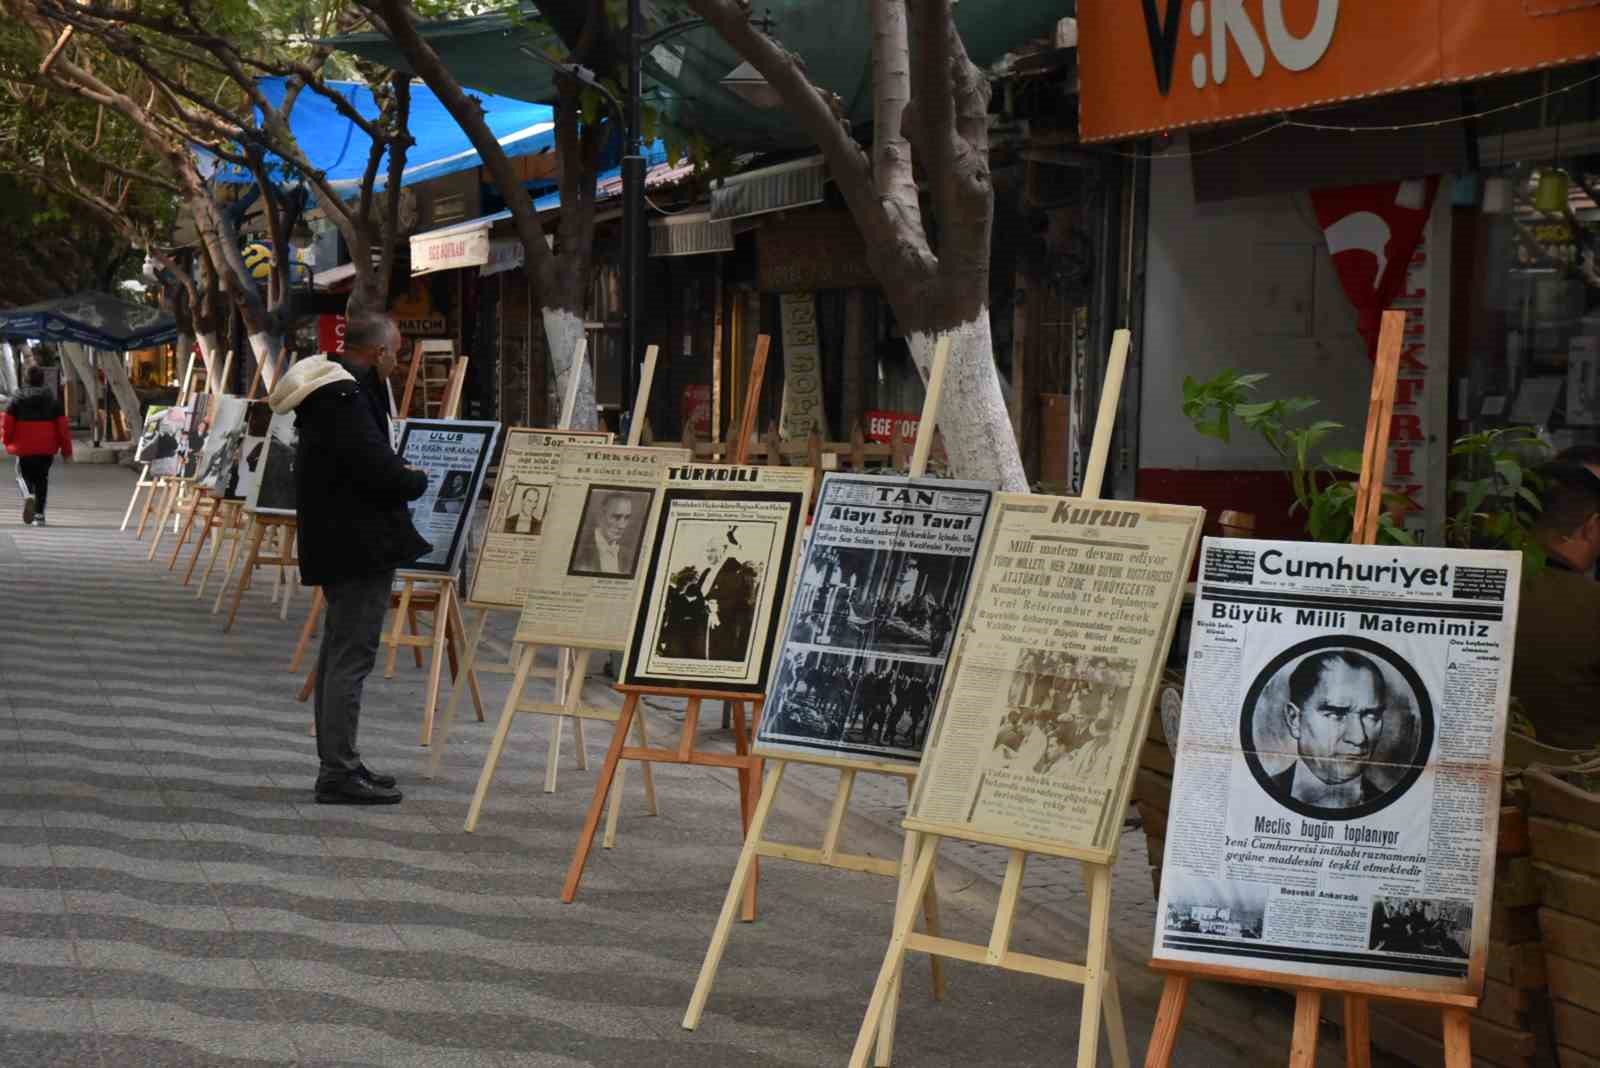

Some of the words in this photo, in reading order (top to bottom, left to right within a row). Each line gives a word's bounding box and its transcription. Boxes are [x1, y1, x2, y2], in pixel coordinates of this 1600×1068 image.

[430, 432, 464, 441] ULUS
[871, 418, 891, 436] EGE
[876, 487, 936, 505] TAN
[830, 506, 876, 526] Atayı
[881, 510, 915, 525] Son
[922, 513, 973, 530] Tavaf
[1051, 501, 1141, 528] Kurun
[1086, 546, 1124, 561] devam
[1259, 549, 1449, 589] Cumhuriyet
[1211, 602, 1283, 624] Büyük
[1359, 613, 1490, 637] Matemimiz
[1224, 835, 1249, 849] Yeni
[1254, 816, 1292, 836] Meclis
[1301, 819, 1335, 840] bugün
[1344, 823, 1400, 846] toplanıyor
[1268, 851, 1324, 869] maddesini
[1362, 860, 1423, 877] etmektedir
